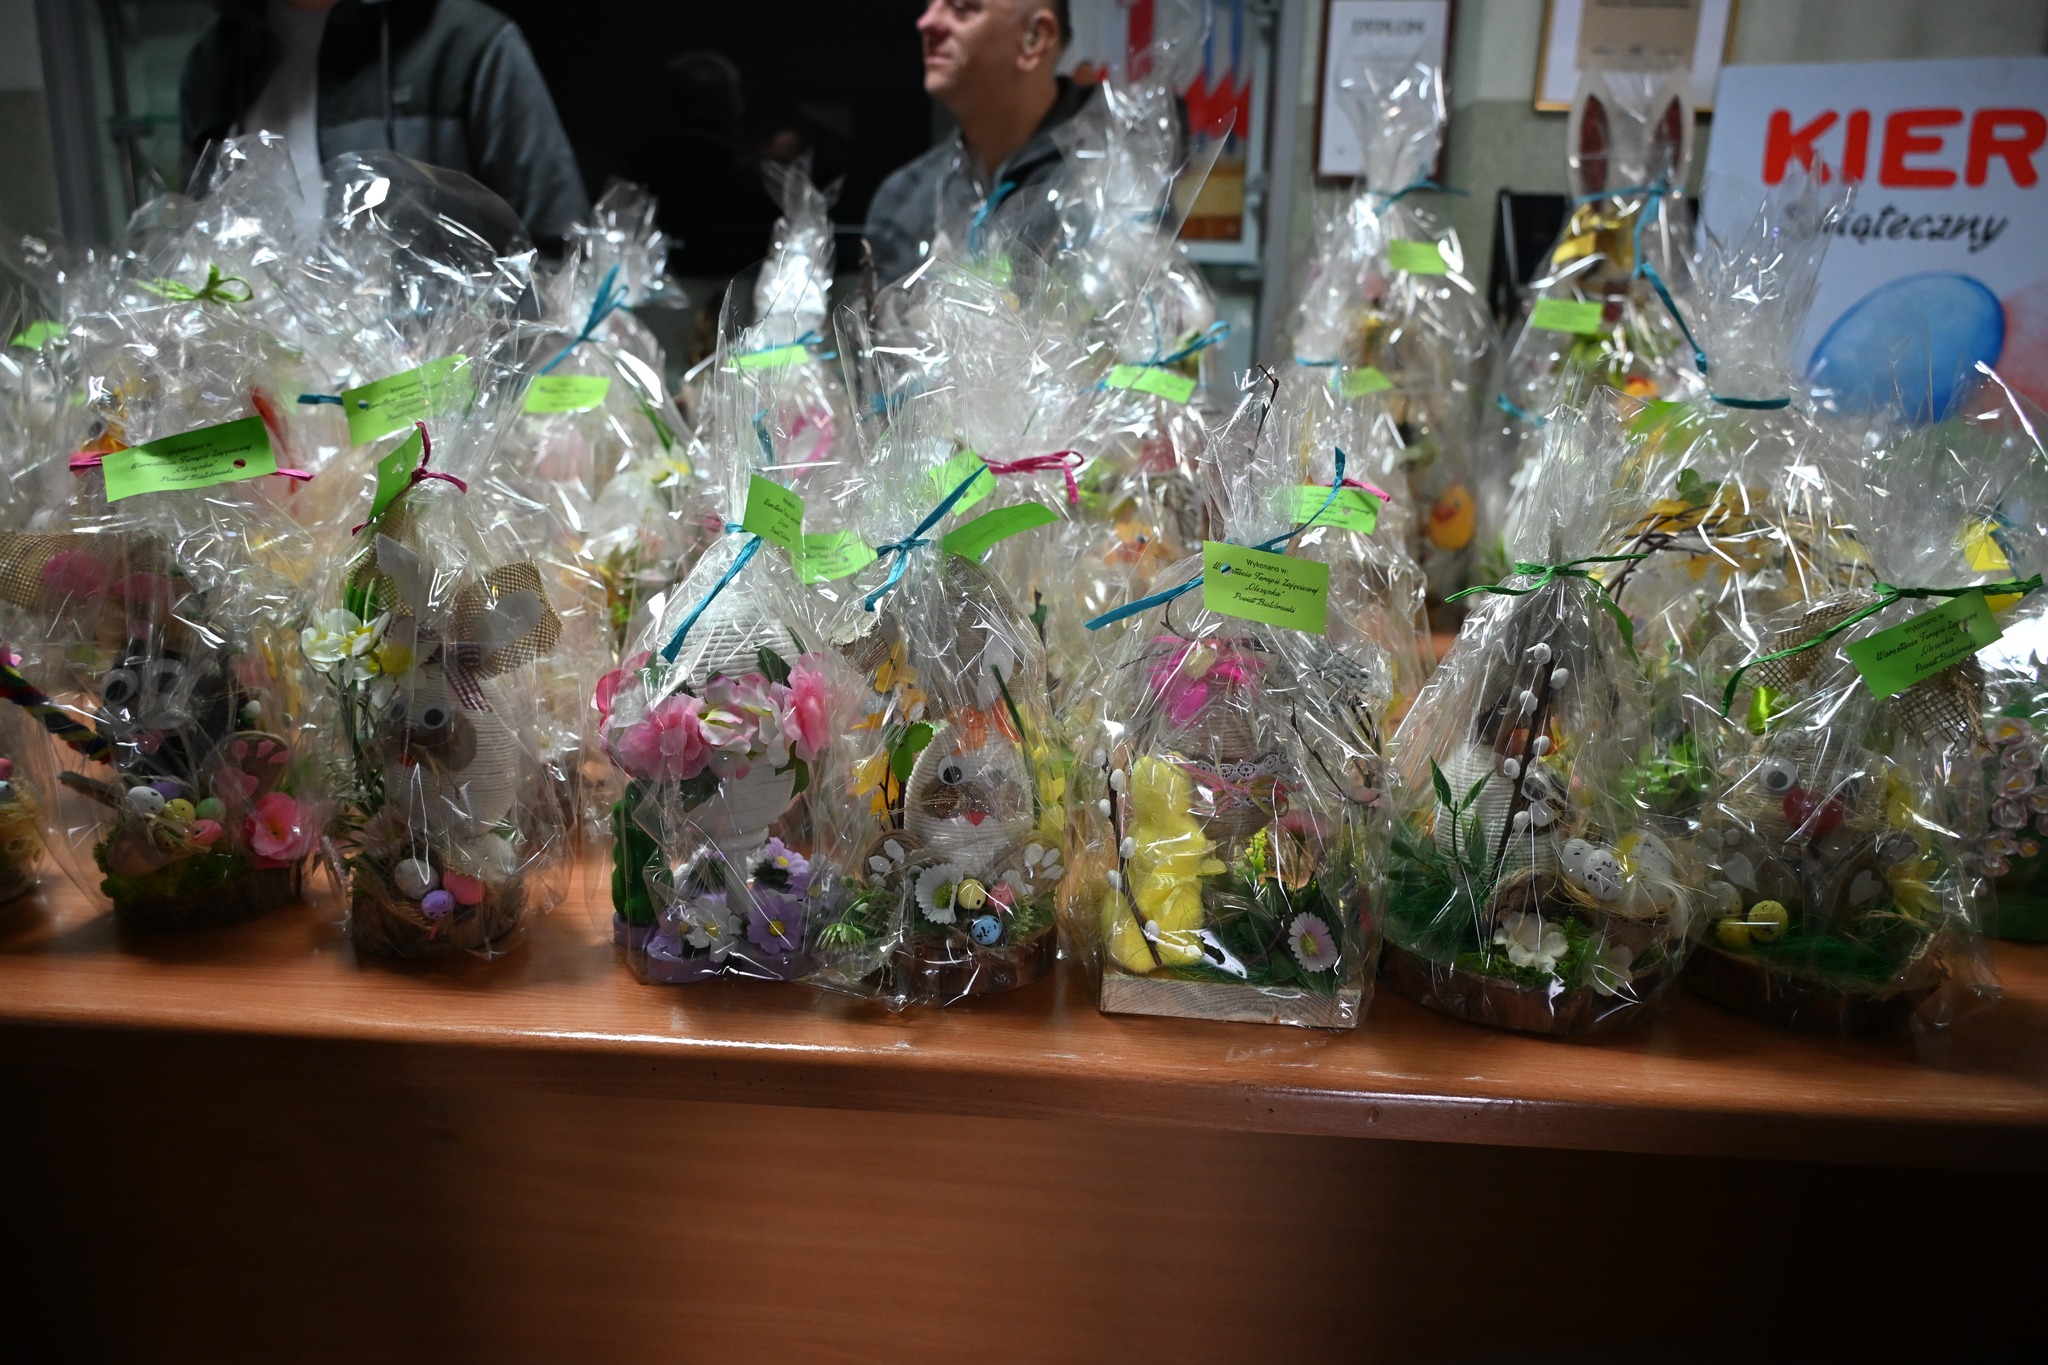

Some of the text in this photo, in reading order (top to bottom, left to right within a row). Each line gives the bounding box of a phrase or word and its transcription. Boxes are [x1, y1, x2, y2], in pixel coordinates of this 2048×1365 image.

[1762, 107, 2047, 189] KIER
[1246, 558, 1280, 573] Wykonano
[1254, 571, 1281, 585] Terapii
[1903, 616, 1938, 634] Wykonano
